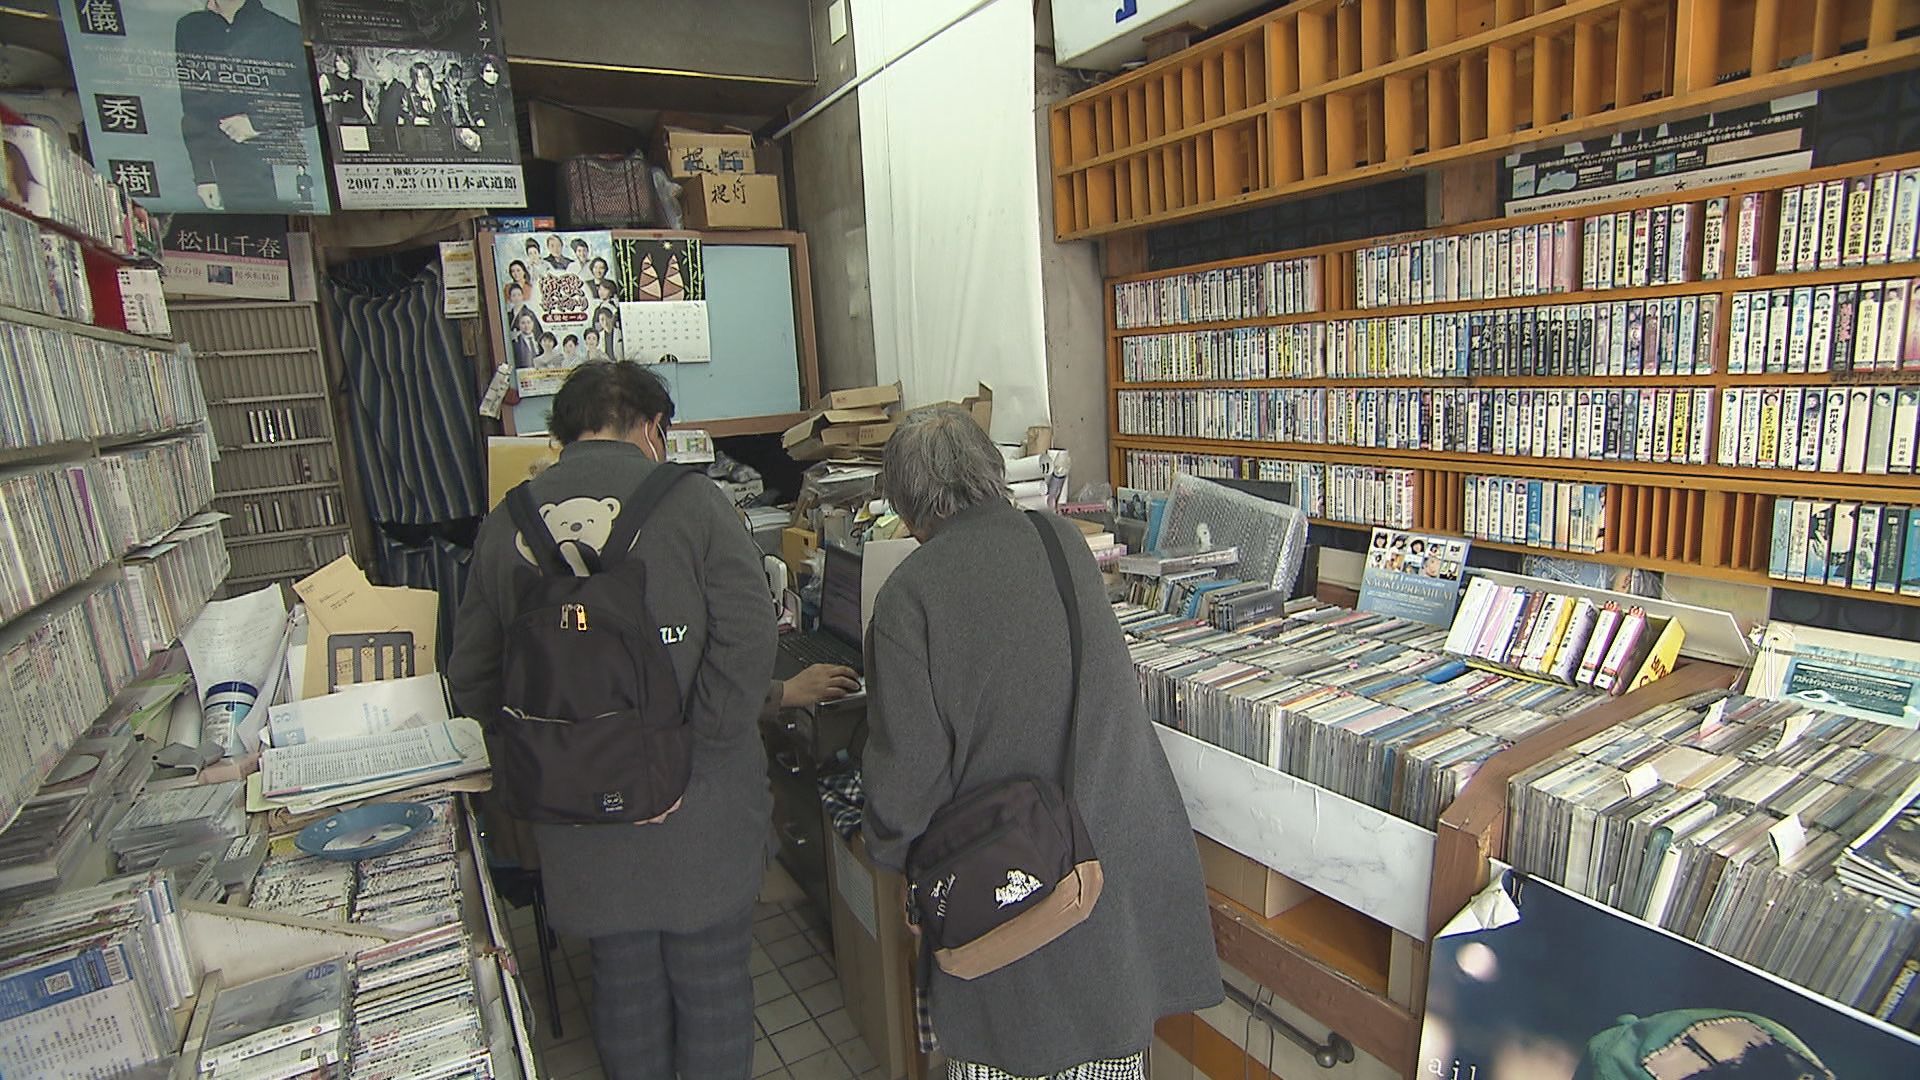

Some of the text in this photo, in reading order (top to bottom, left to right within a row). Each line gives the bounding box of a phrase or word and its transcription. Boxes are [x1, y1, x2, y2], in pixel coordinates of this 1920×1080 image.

[217, 71, 271, 88] 2001
[219, 63, 233, 74] IN
[236, 64, 287, 77] STORES
[103, 100, 138, 130] 秀
[115, 162, 151, 195] 樹
[176, 229, 281, 259] 松山千春
